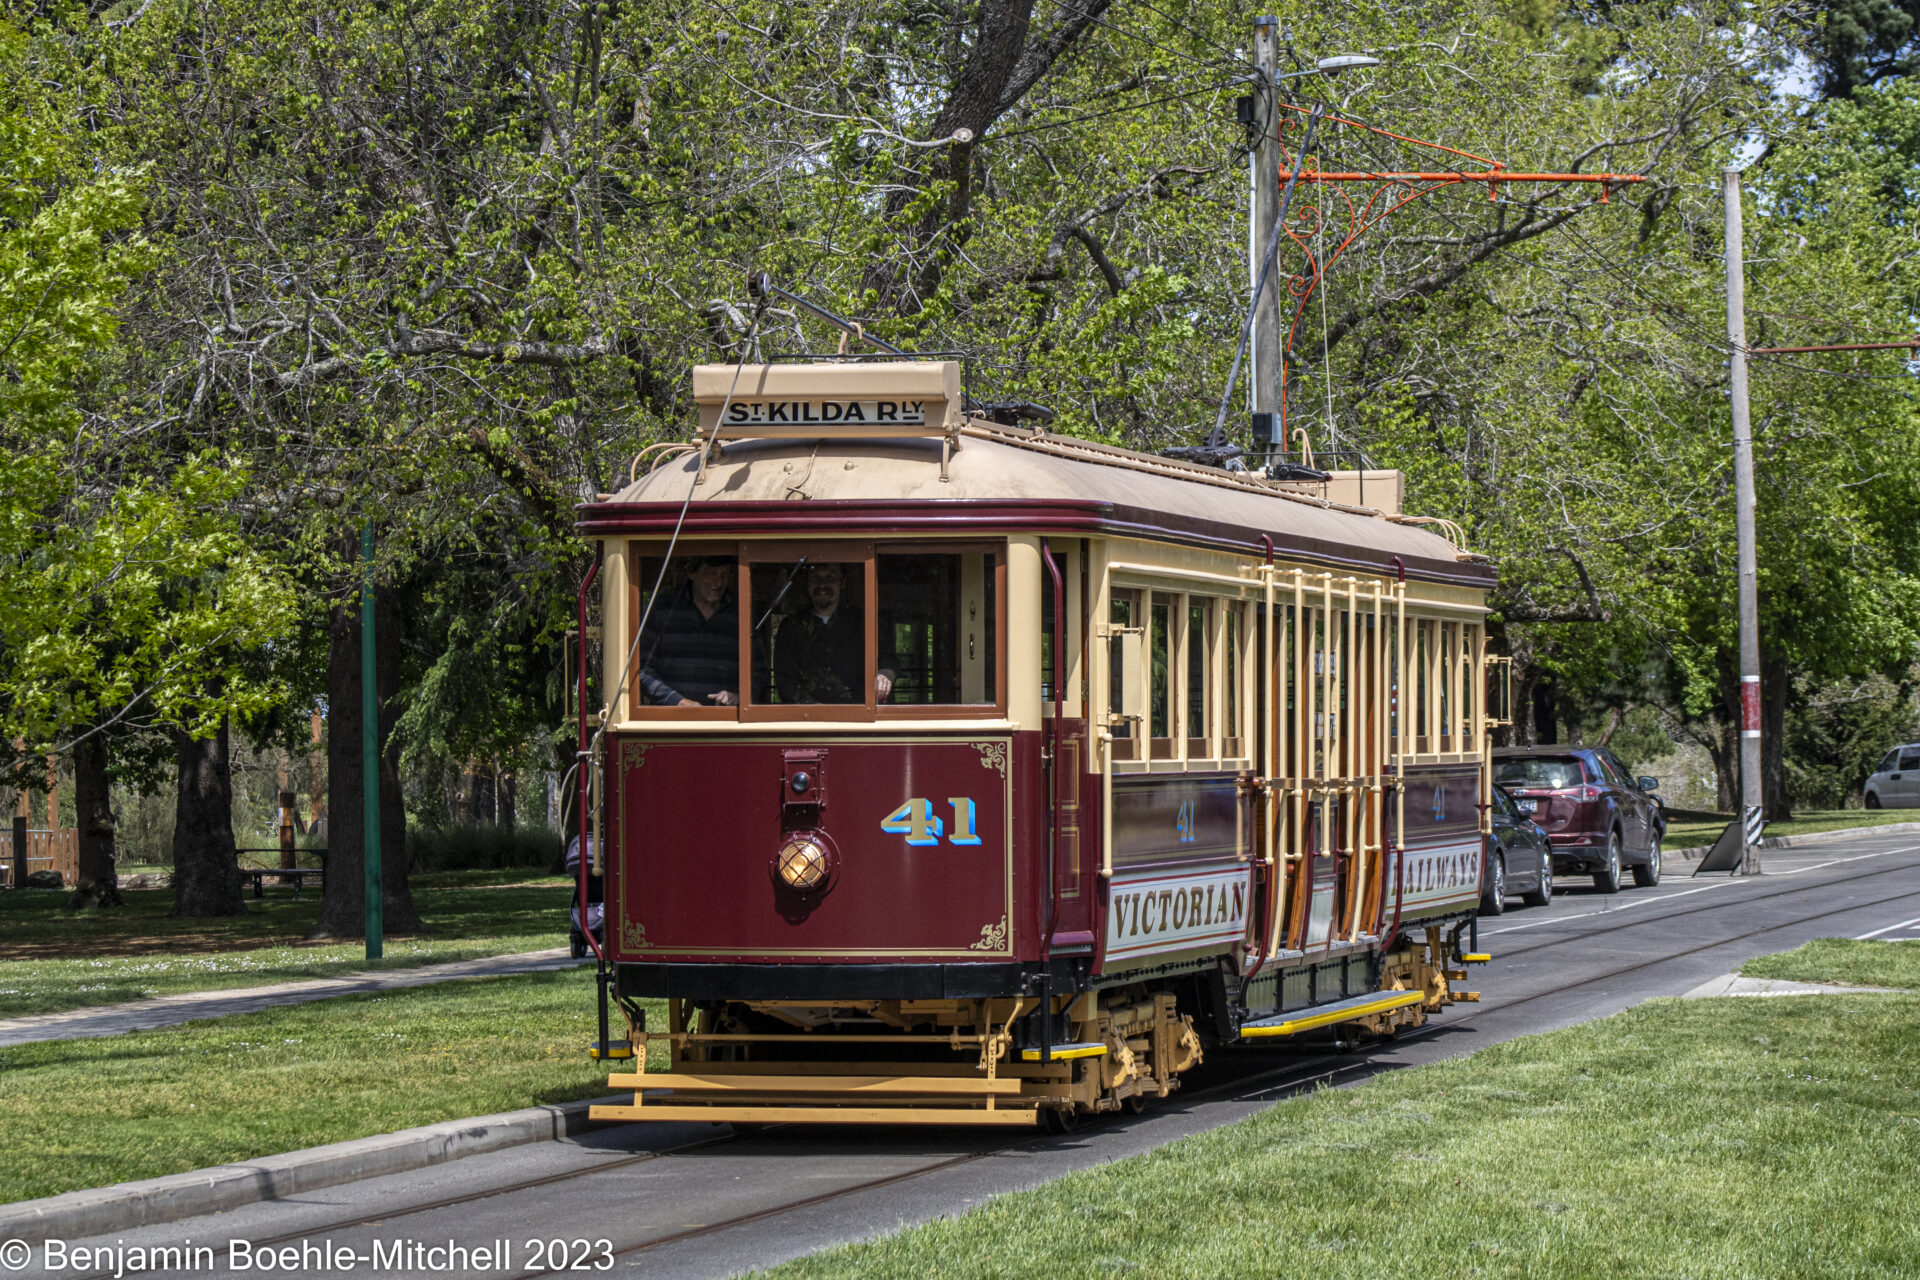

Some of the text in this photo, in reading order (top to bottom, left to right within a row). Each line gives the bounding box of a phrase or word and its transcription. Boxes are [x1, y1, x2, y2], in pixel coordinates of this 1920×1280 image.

[768, 402, 866, 421] KILDA
[880, 797, 982, 846] 41
[1176, 799, 1195, 842] 41
[1114, 881, 1247, 939] VICTORIAN
